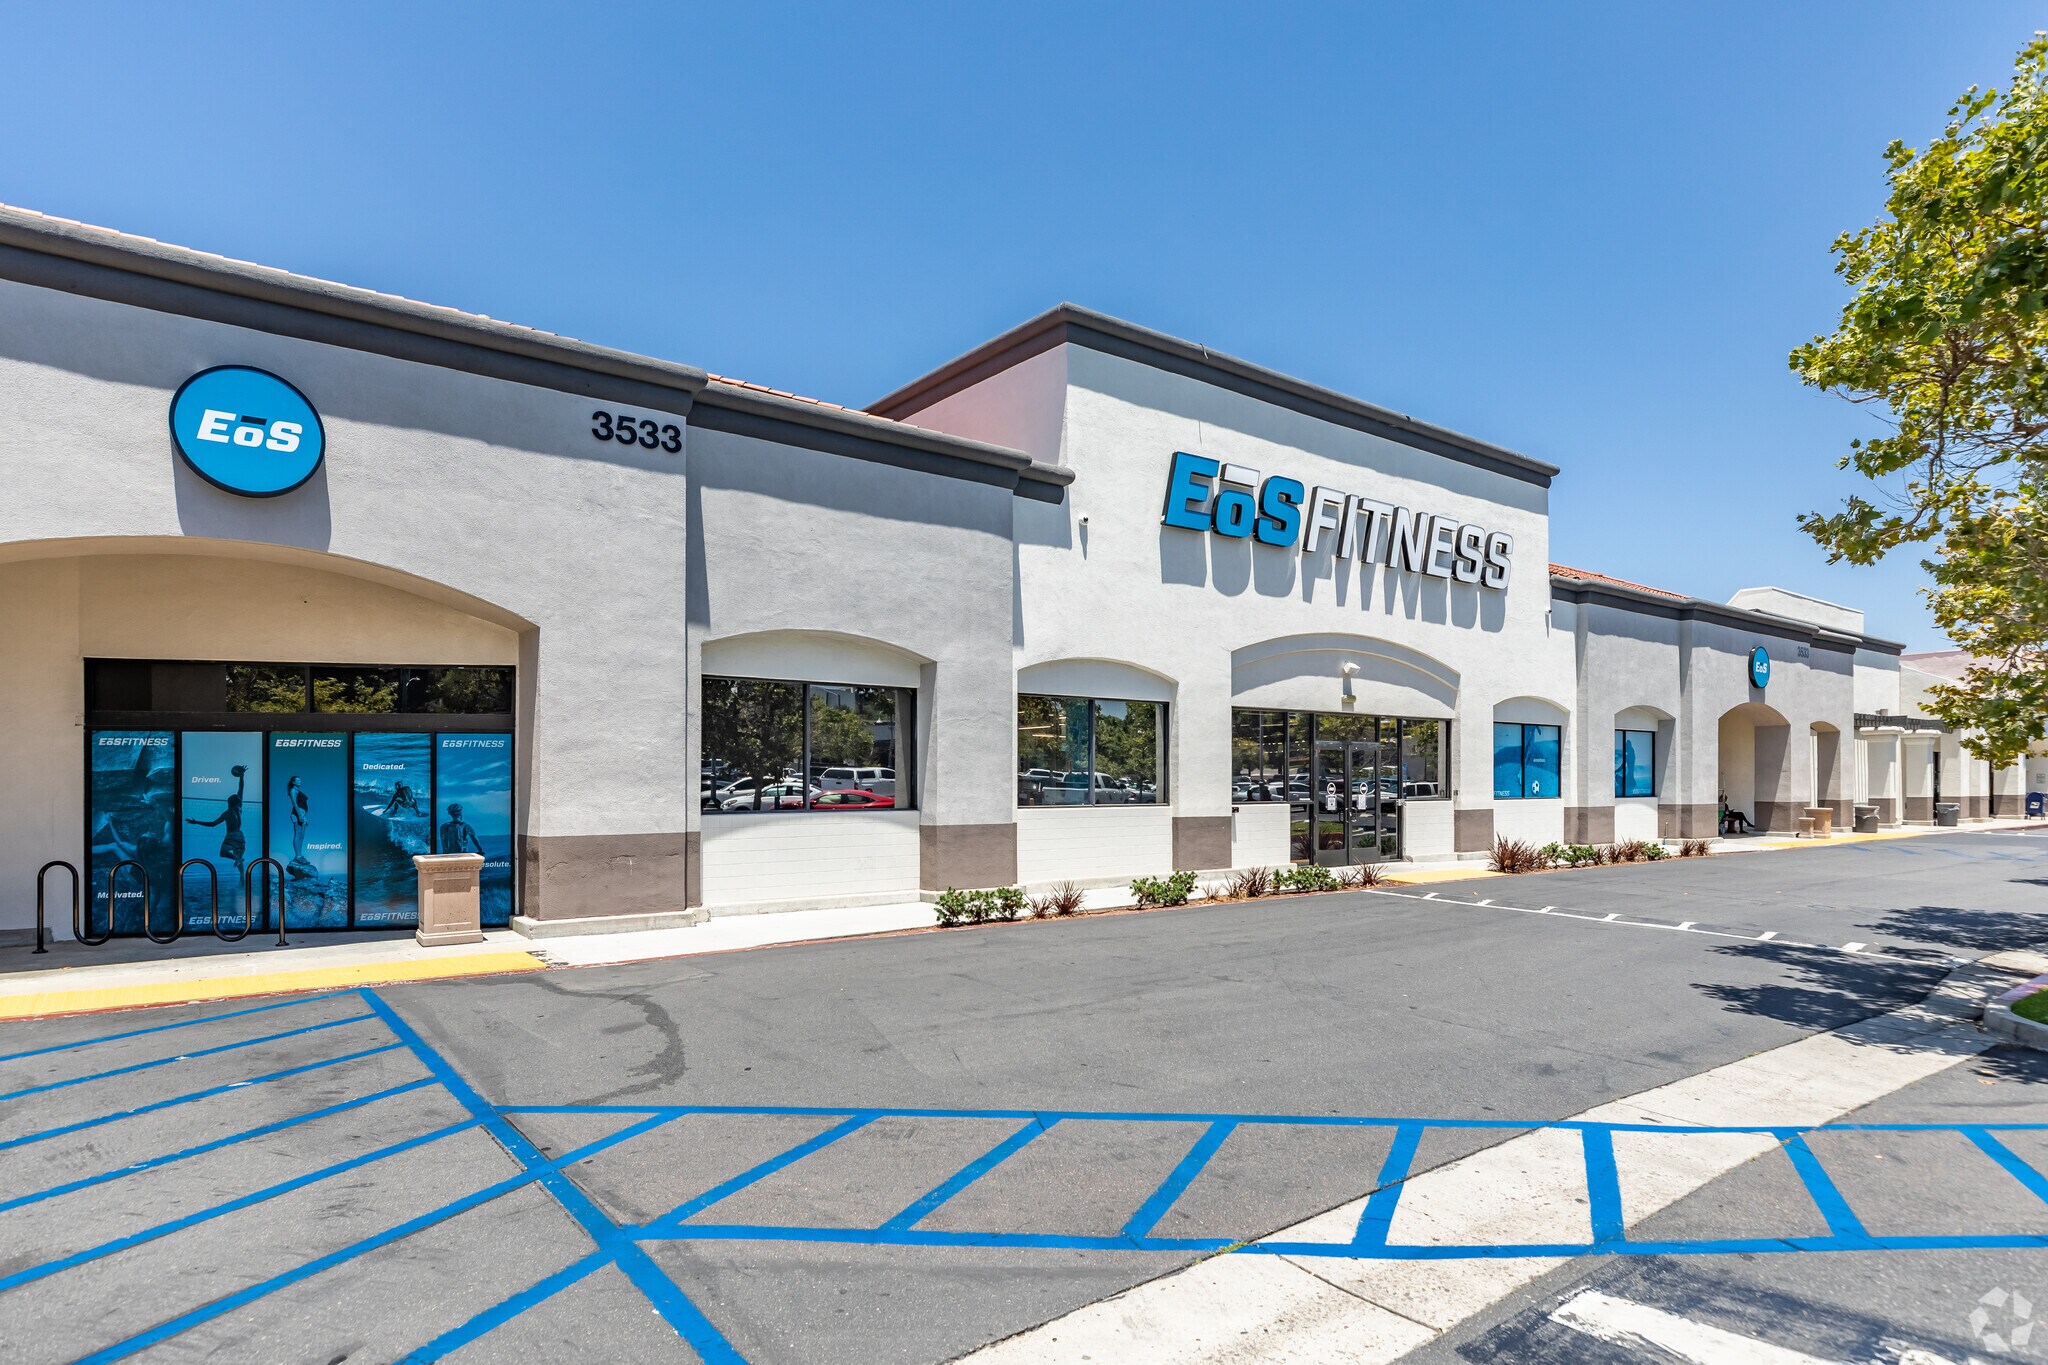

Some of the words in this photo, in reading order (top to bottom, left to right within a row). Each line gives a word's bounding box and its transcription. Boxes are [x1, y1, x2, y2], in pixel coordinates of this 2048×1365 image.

[591, 411, 683, 455] 3533
[1302, 485, 1514, 590] FITNESS
[362, 763, 406, 771] Dedicated.
[191, 776, 222, 784] Driven.
[306, 842, 343, 851] Inspired.
[97, 891, 145, 899] Moivated.
